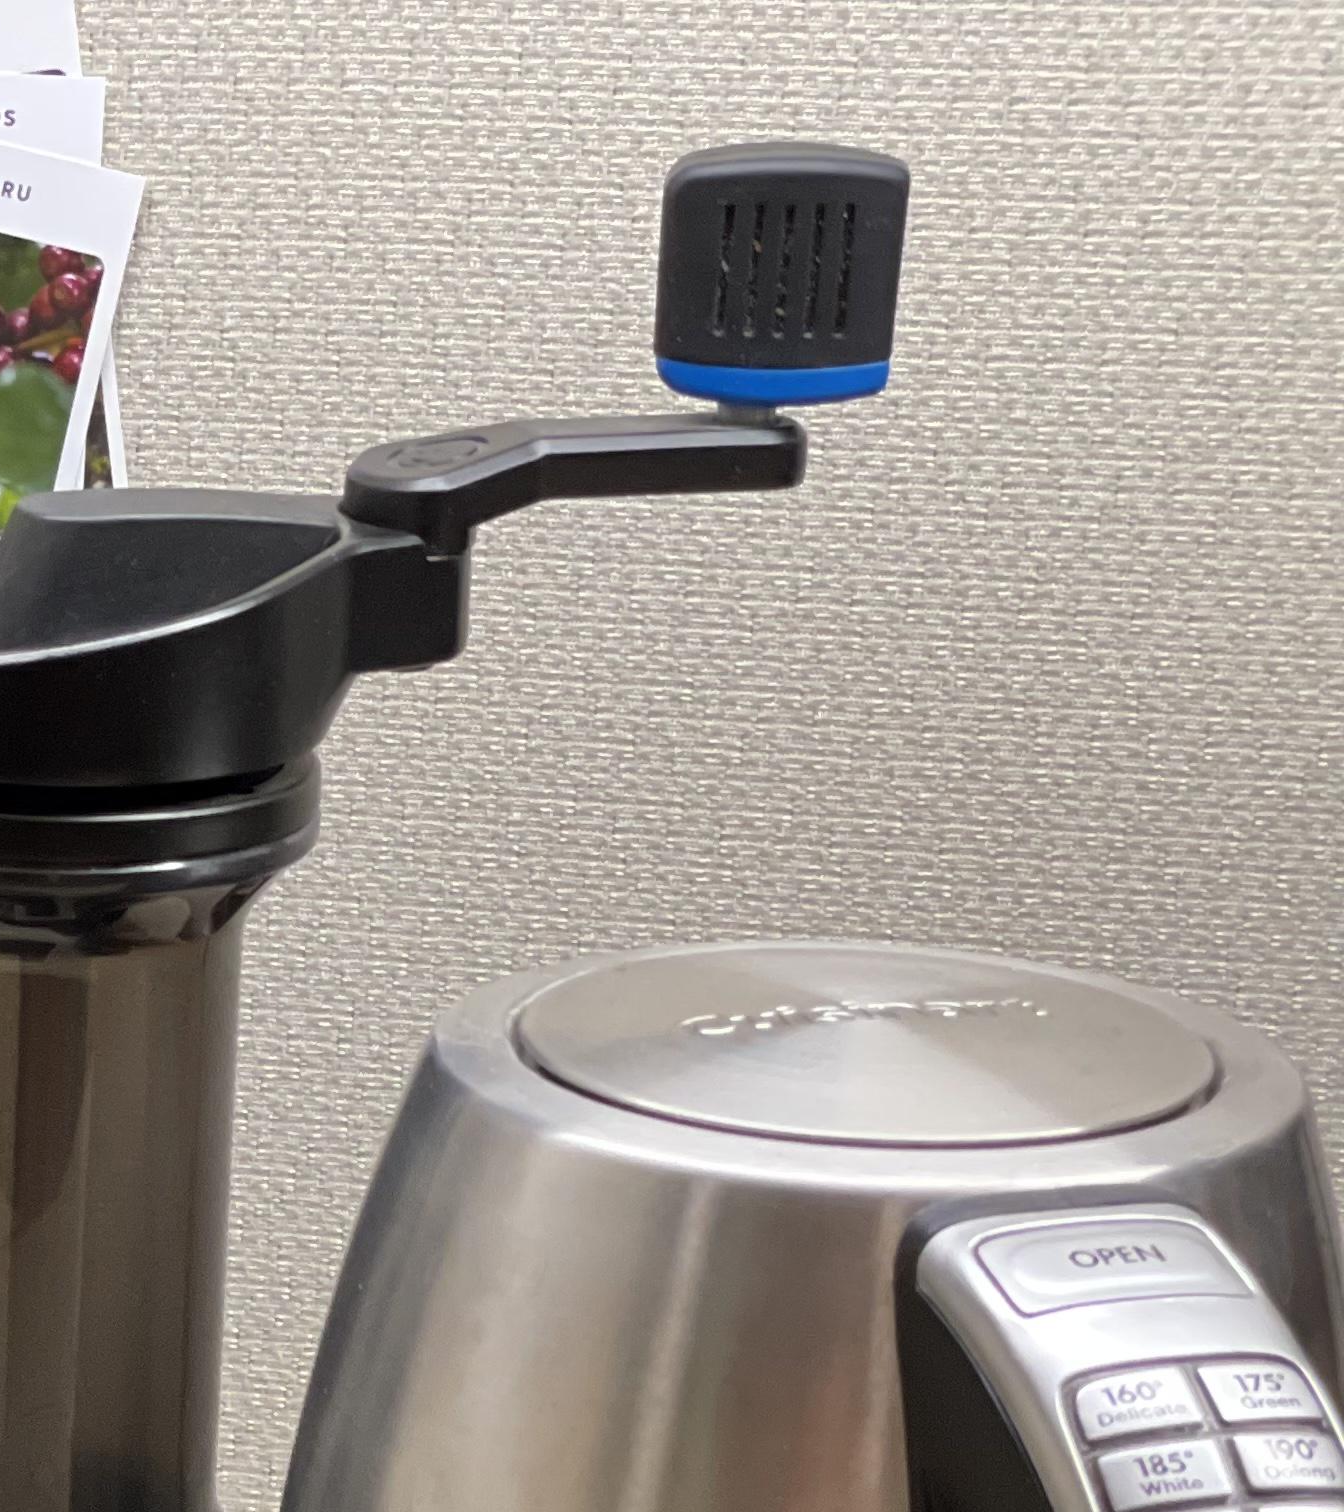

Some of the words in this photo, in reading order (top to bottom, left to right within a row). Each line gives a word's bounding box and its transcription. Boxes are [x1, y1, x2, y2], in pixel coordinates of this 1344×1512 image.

[1068, 1243, 1167, 1268] OPEN
[1240, 1394, 1302, 1410] Green
[1097, 1403, 1189, 1428] Delicate
[1139, 1477, 1204, 1497] White
